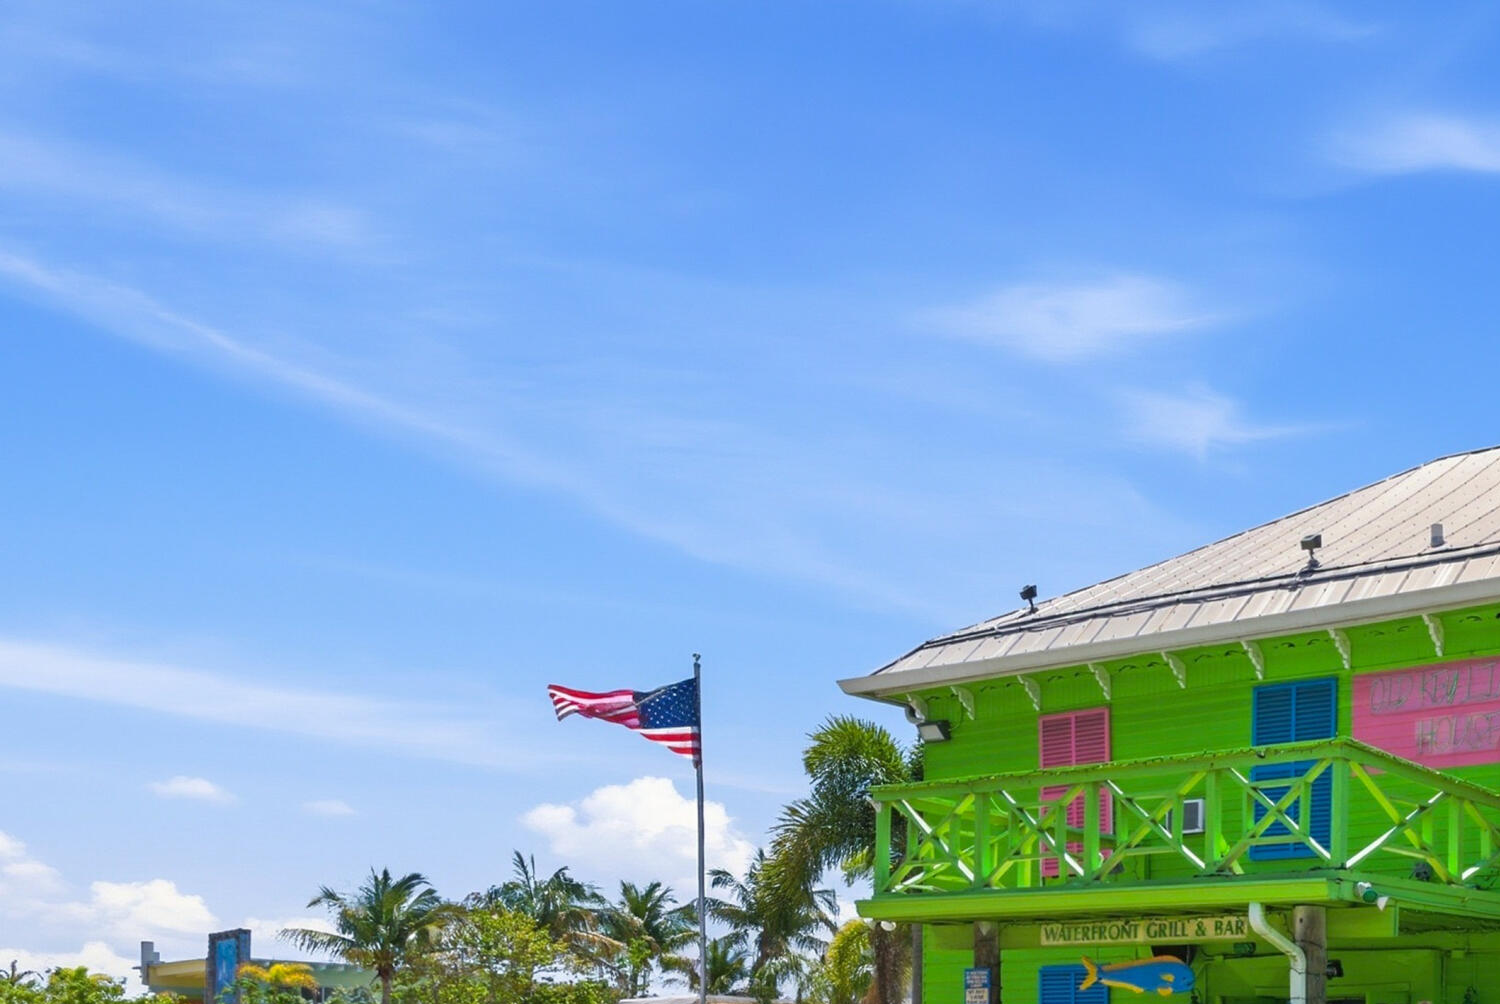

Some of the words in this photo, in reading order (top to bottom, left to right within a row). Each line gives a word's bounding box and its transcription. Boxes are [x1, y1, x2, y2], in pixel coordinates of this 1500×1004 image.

[1370, 674, 1413, 712] OLD
[1043, 923, 1140, 942] WATERFRONT
[1146, 920, 1189, 939] GRILL
[1195, 920, 1206, 937] &
[1214, 918, 1245, 936] BAR
